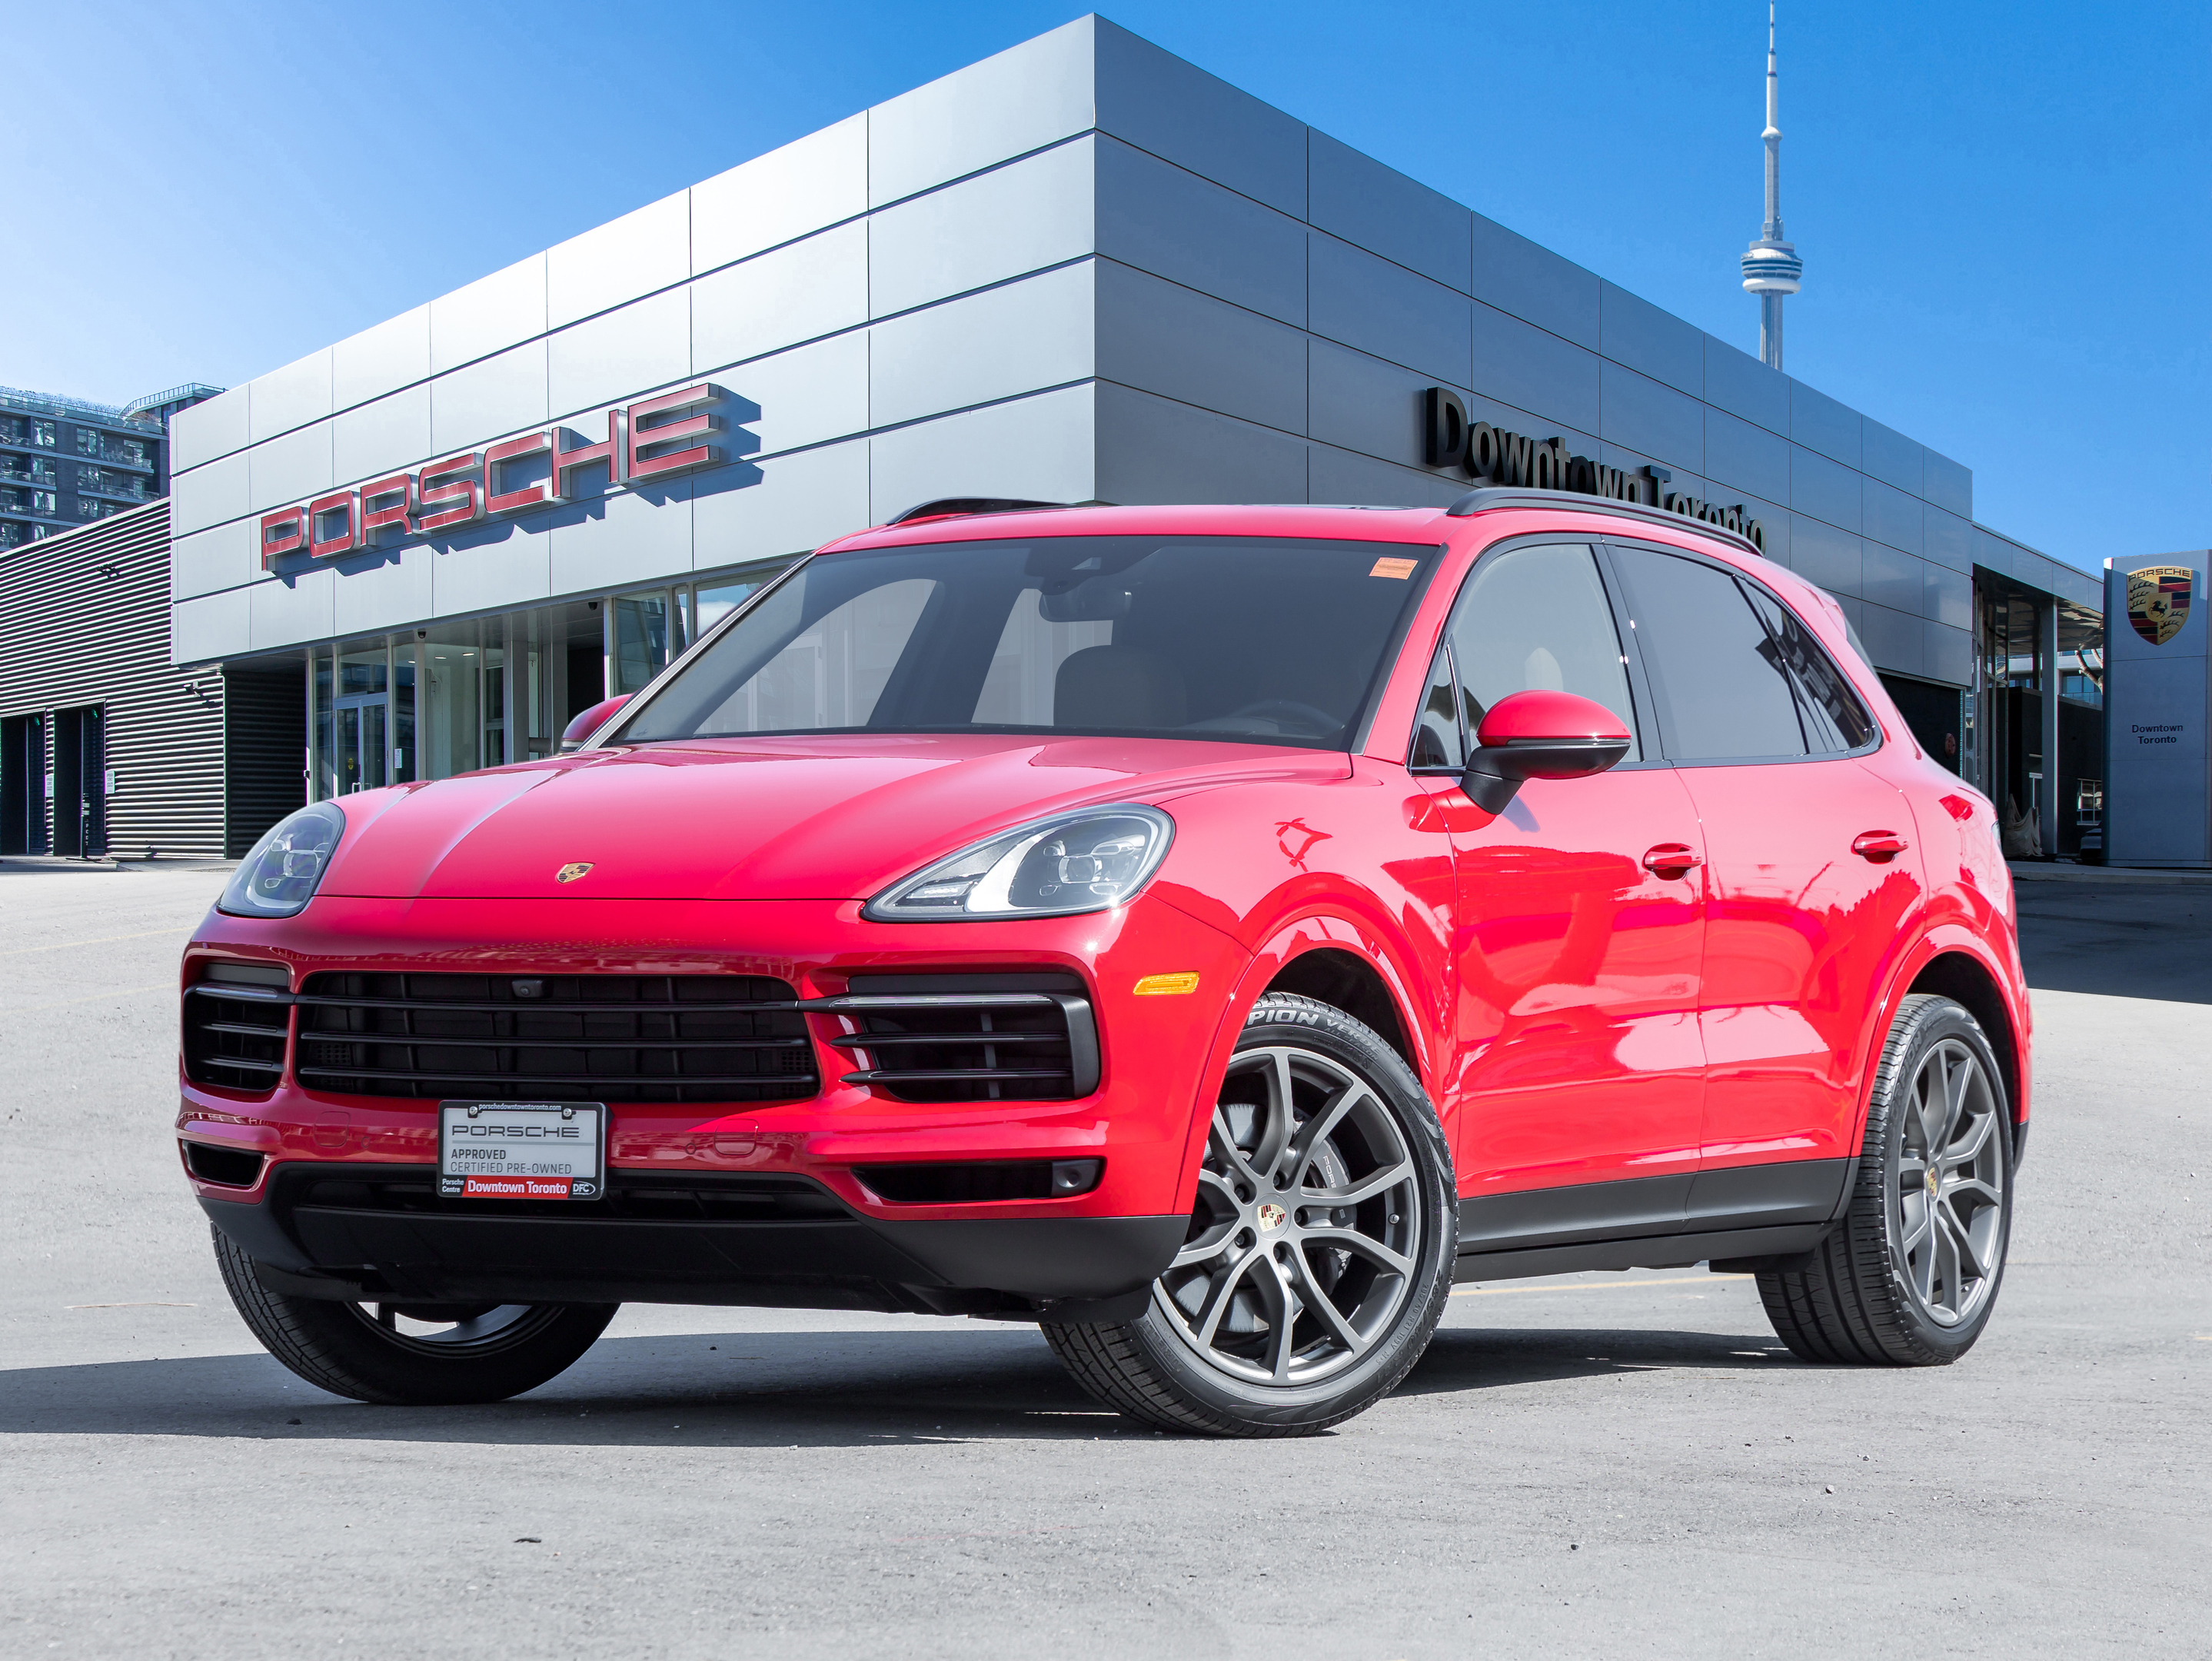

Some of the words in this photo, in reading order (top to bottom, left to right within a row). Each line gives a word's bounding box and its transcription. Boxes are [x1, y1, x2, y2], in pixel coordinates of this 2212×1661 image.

[261, 383, 720, 571] PORSCHE
[1426, 386, 1641, 504] Downtown
[1644, 464, 1766, 557] Toronto
[2128, 568, 2190, 581] PORSCHE
[2131, 724, 2184, 733] Downtown
[2137, 736, 2177, 744] Toronto
[1326, 1019, 1381, 1055] VERDE
[478, 1103, 561, 1111] porschedowntowntoronto.com
[452, 1125, 580, 1138] PORSCHE
[451, 1149, 507, 1160] APPROVED
[451, 1162, 503, 1173] CERTIFIED
[507, 1163, 572, 1174] PRE-OWNED
[467, 1180, 525, 1193] Downtown
[526, 1181, 567, 1194] Toronto
[573, 1183, 590, 1193] DFC
